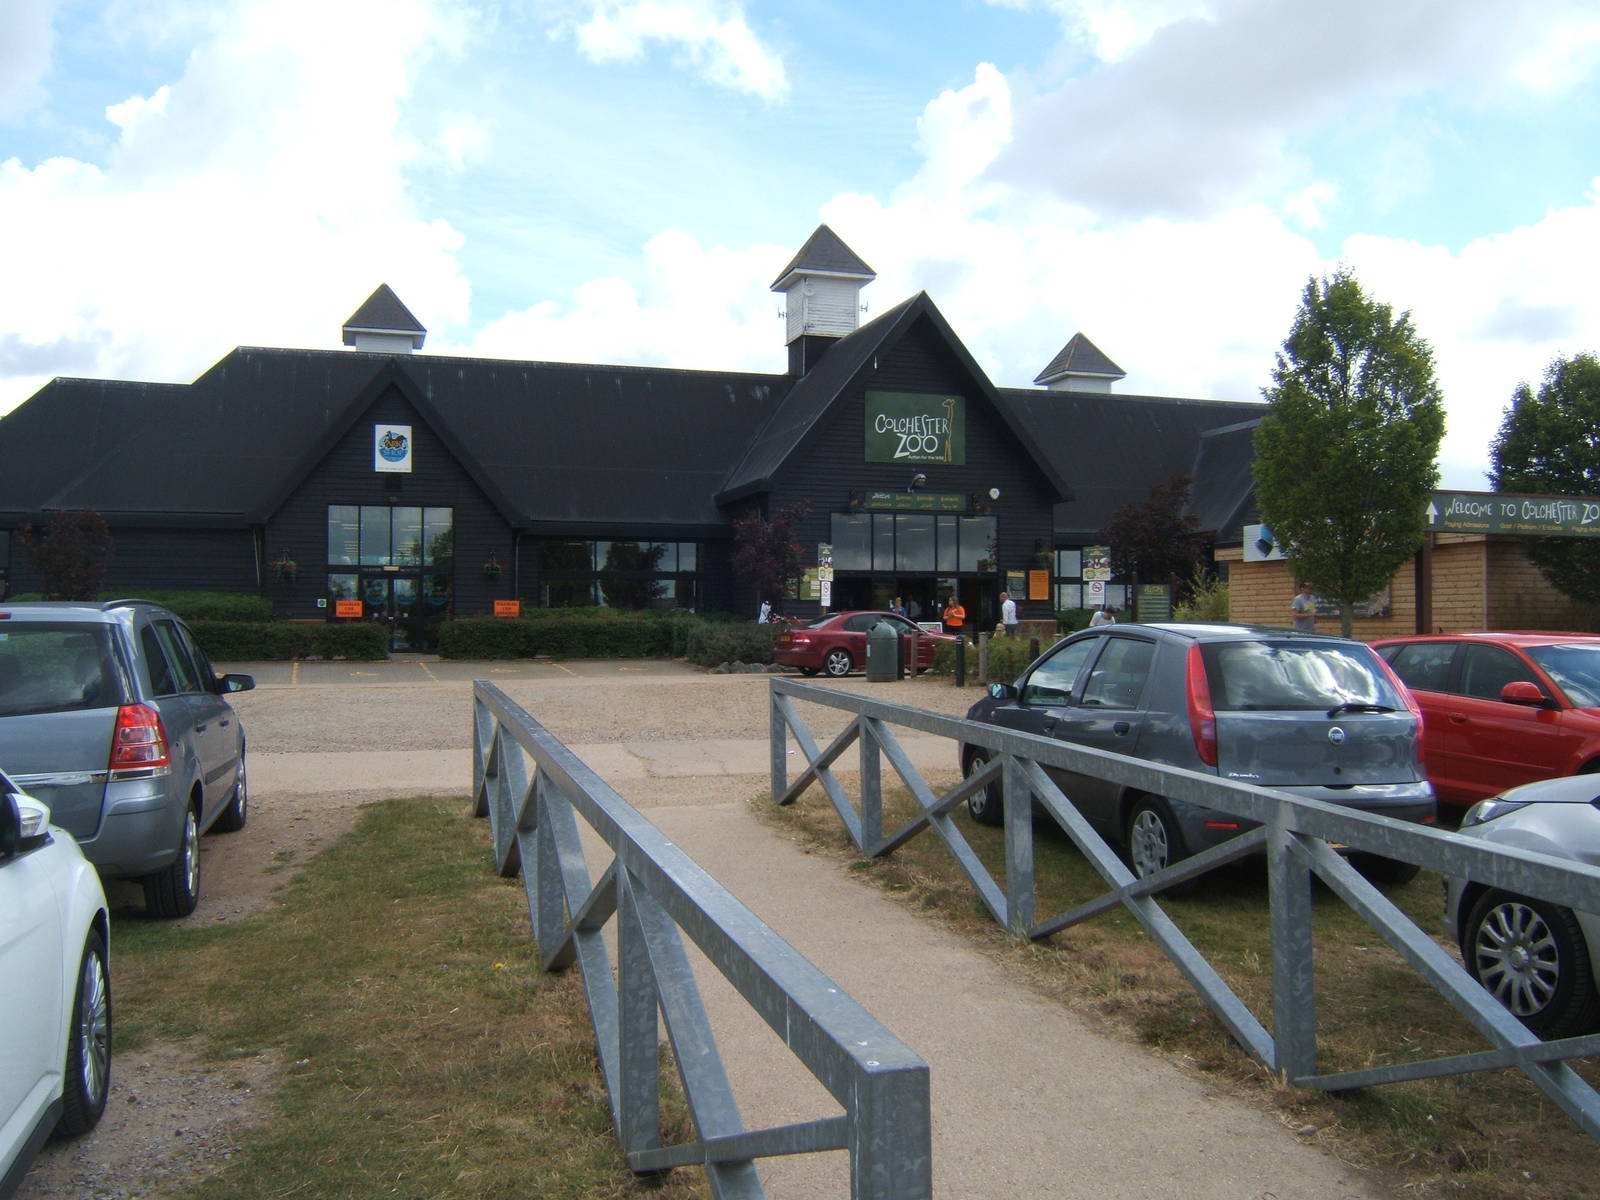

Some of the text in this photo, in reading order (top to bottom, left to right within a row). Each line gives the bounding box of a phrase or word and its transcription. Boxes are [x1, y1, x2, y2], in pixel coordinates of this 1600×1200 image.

[875, 414, 949, 438] COLCHESTER
[893, 433, 938, 459] ZOO
[1445, 498, 1493, 517] WELCOME
[1501, 503, 1517, 517] TO
[1522, 501, 1578, 524] COLCHESTER
